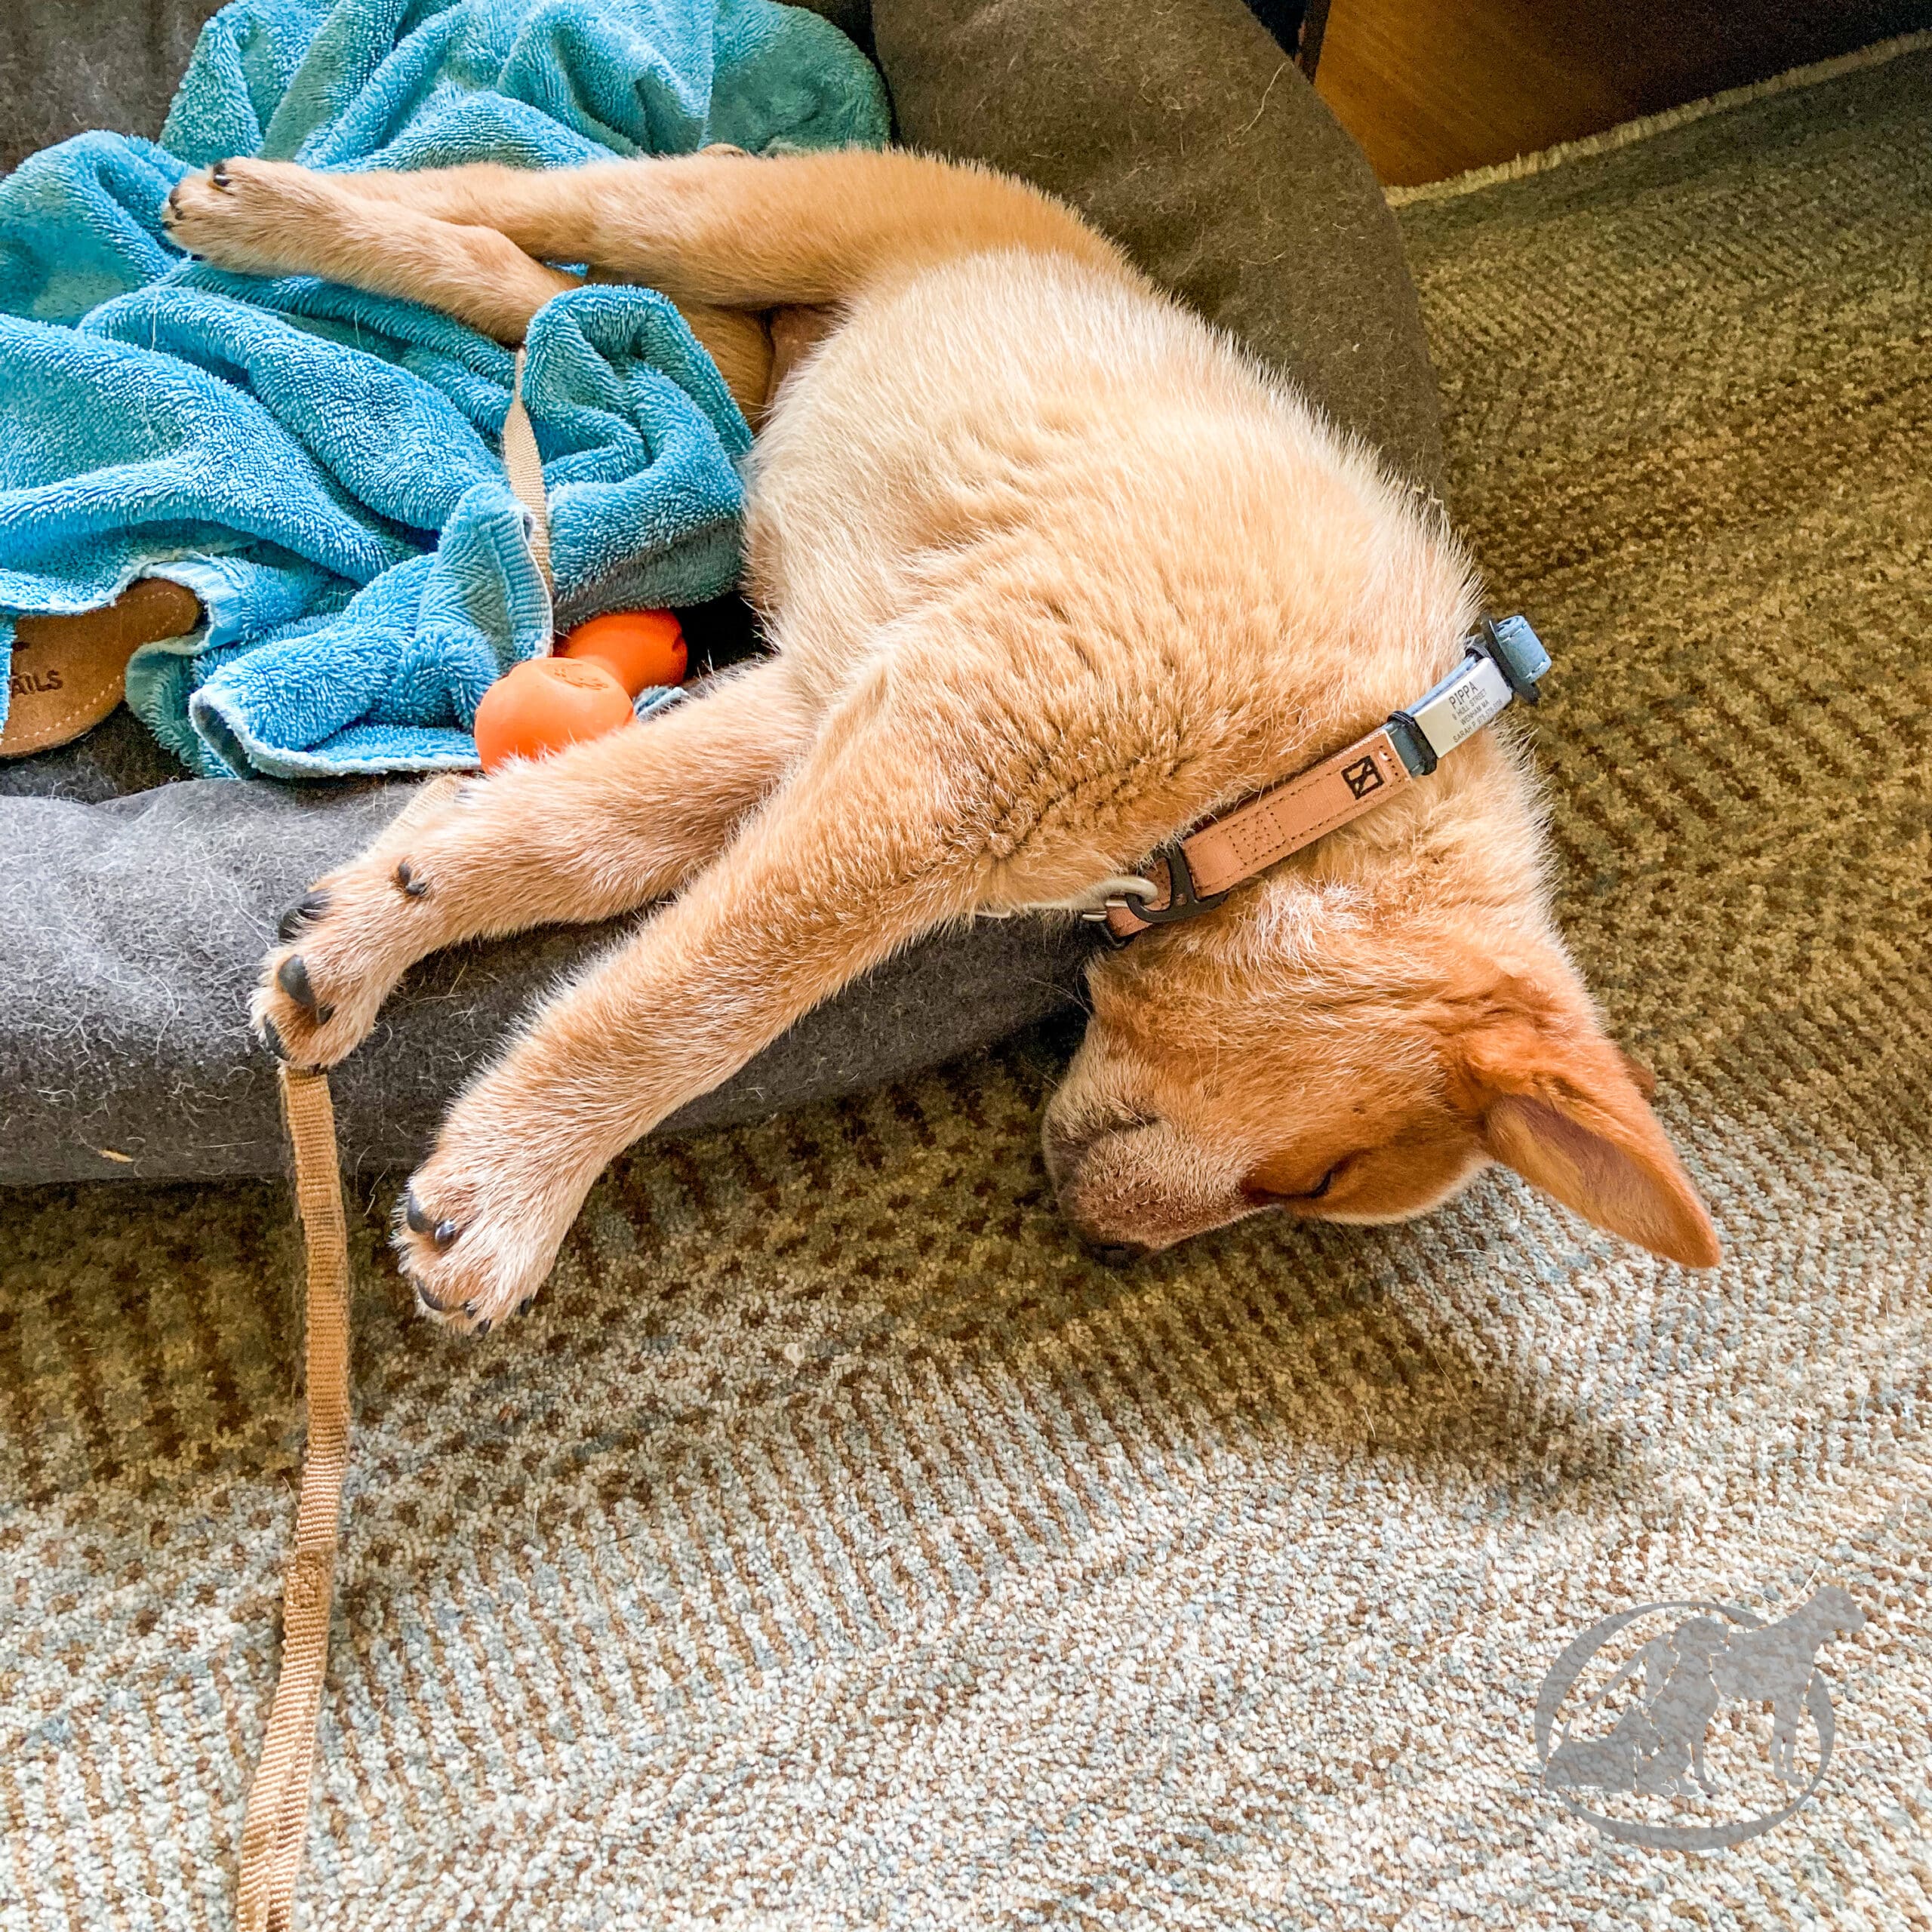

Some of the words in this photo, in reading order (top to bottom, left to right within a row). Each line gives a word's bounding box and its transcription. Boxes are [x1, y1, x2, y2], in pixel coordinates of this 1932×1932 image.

[10, 669, 63, 699] AILS
[1448, 681, 1478, 709] PIPPA
[1469, 688, 1486, 706] STREET
[1460, 705, 1481, 725] WENHAM
[1481, 700, 1489, 708] MA
[1453, 724, 1472, 743] SARAH
